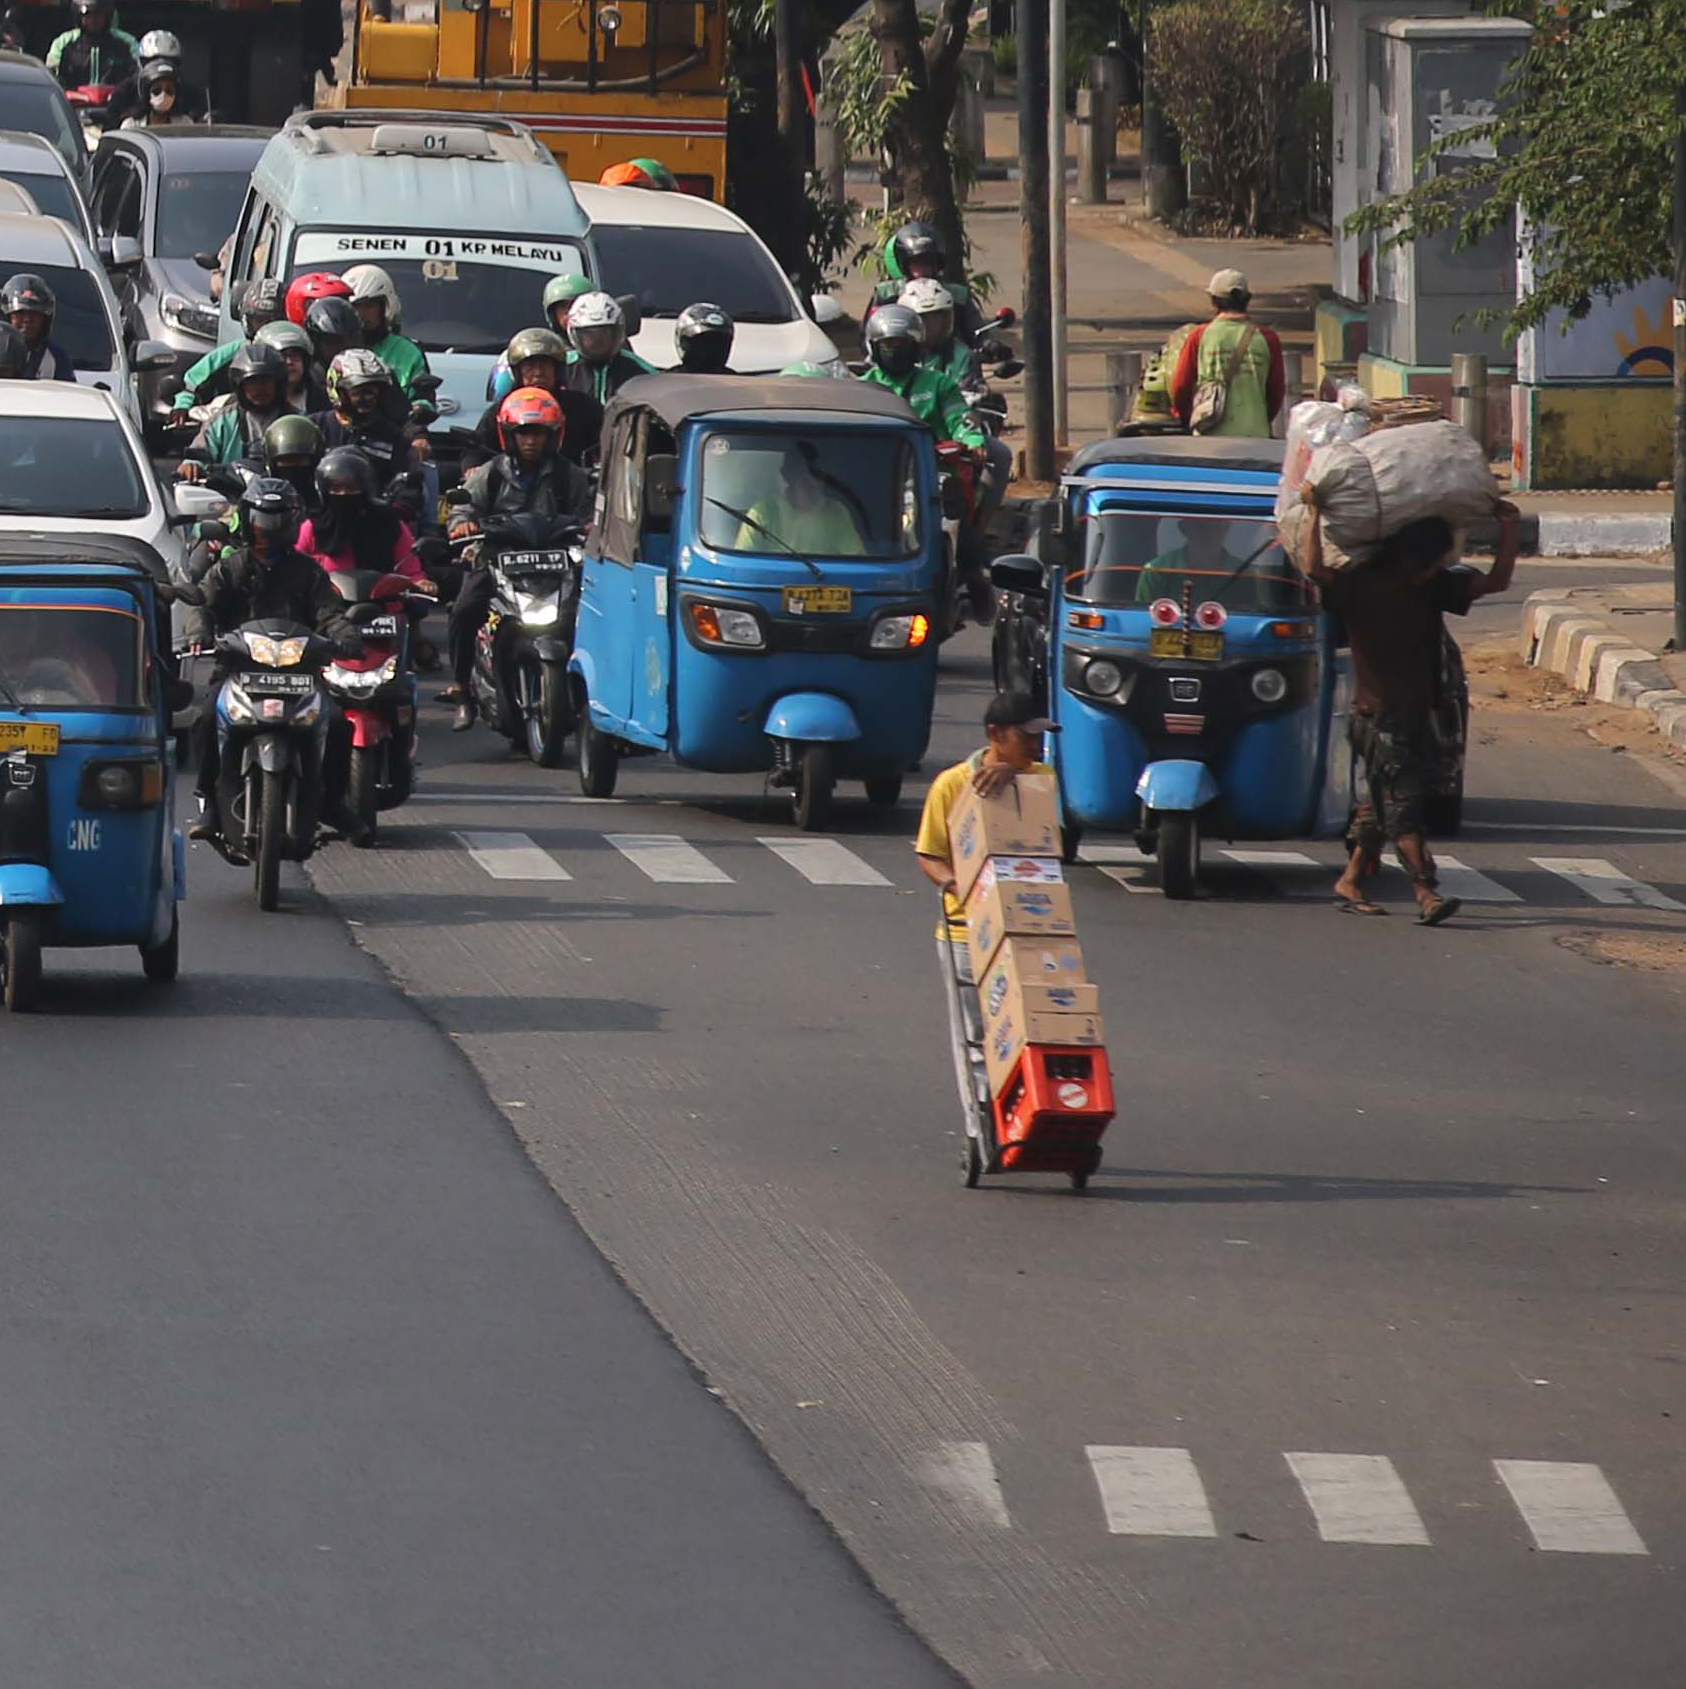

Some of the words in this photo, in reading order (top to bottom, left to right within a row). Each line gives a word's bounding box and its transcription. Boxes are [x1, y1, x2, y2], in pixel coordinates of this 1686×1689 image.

[423, 135, 448, 151] 01
[337, 238, 407, 251] SENEN
[425, 239, 455, 256] 01
[491, 244, 563, 262] MELAYU
[421, 259, 459, 280] 01
[67, 819, 100, 851] CNG
